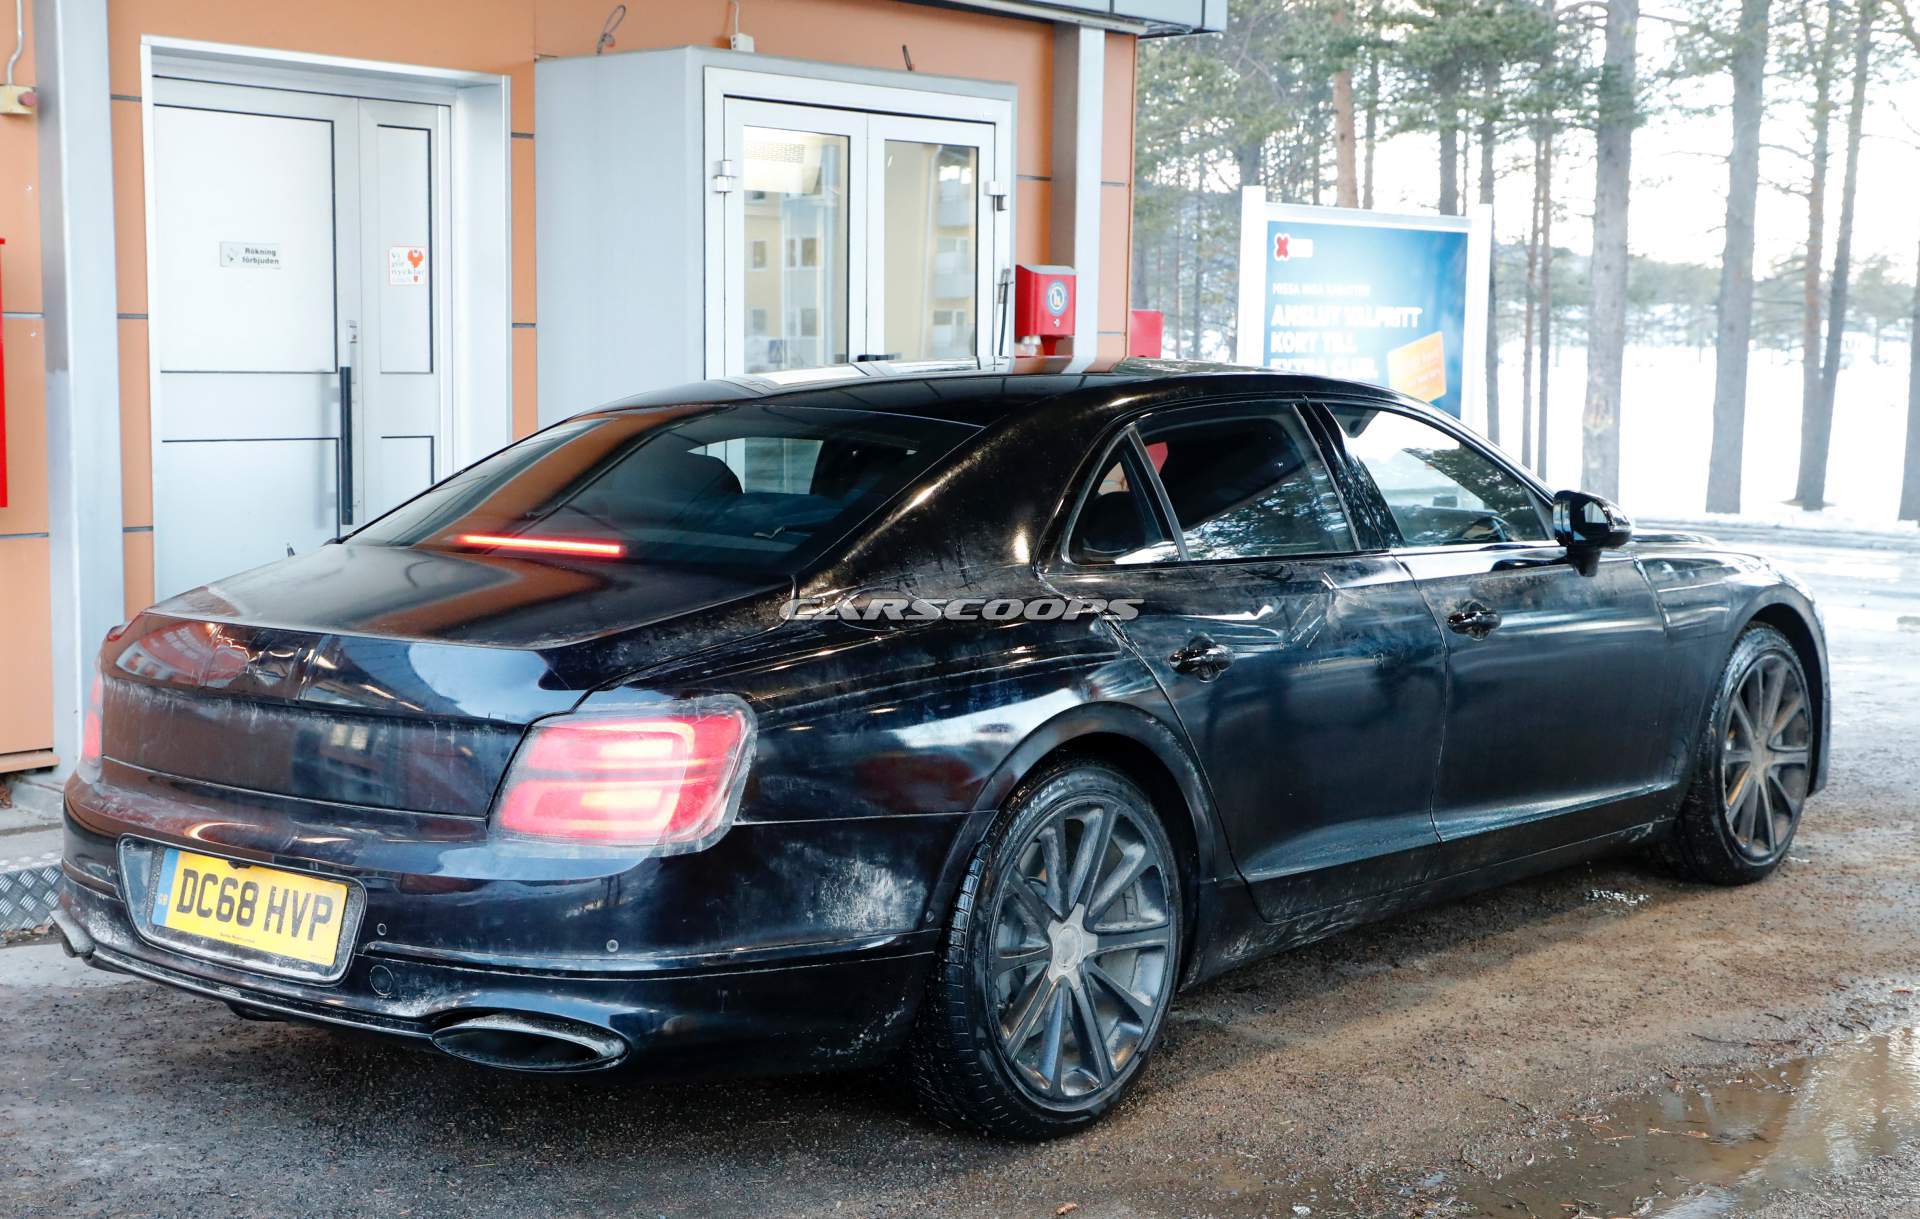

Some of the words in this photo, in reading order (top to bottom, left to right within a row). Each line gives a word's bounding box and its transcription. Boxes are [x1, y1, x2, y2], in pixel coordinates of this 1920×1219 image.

[244, 247, 276, 257] Rökning
[241, 256, 279, 265] förbjuden
[176, 868, 259, 927] DC68
[263, 886, 333, 941] HVP
